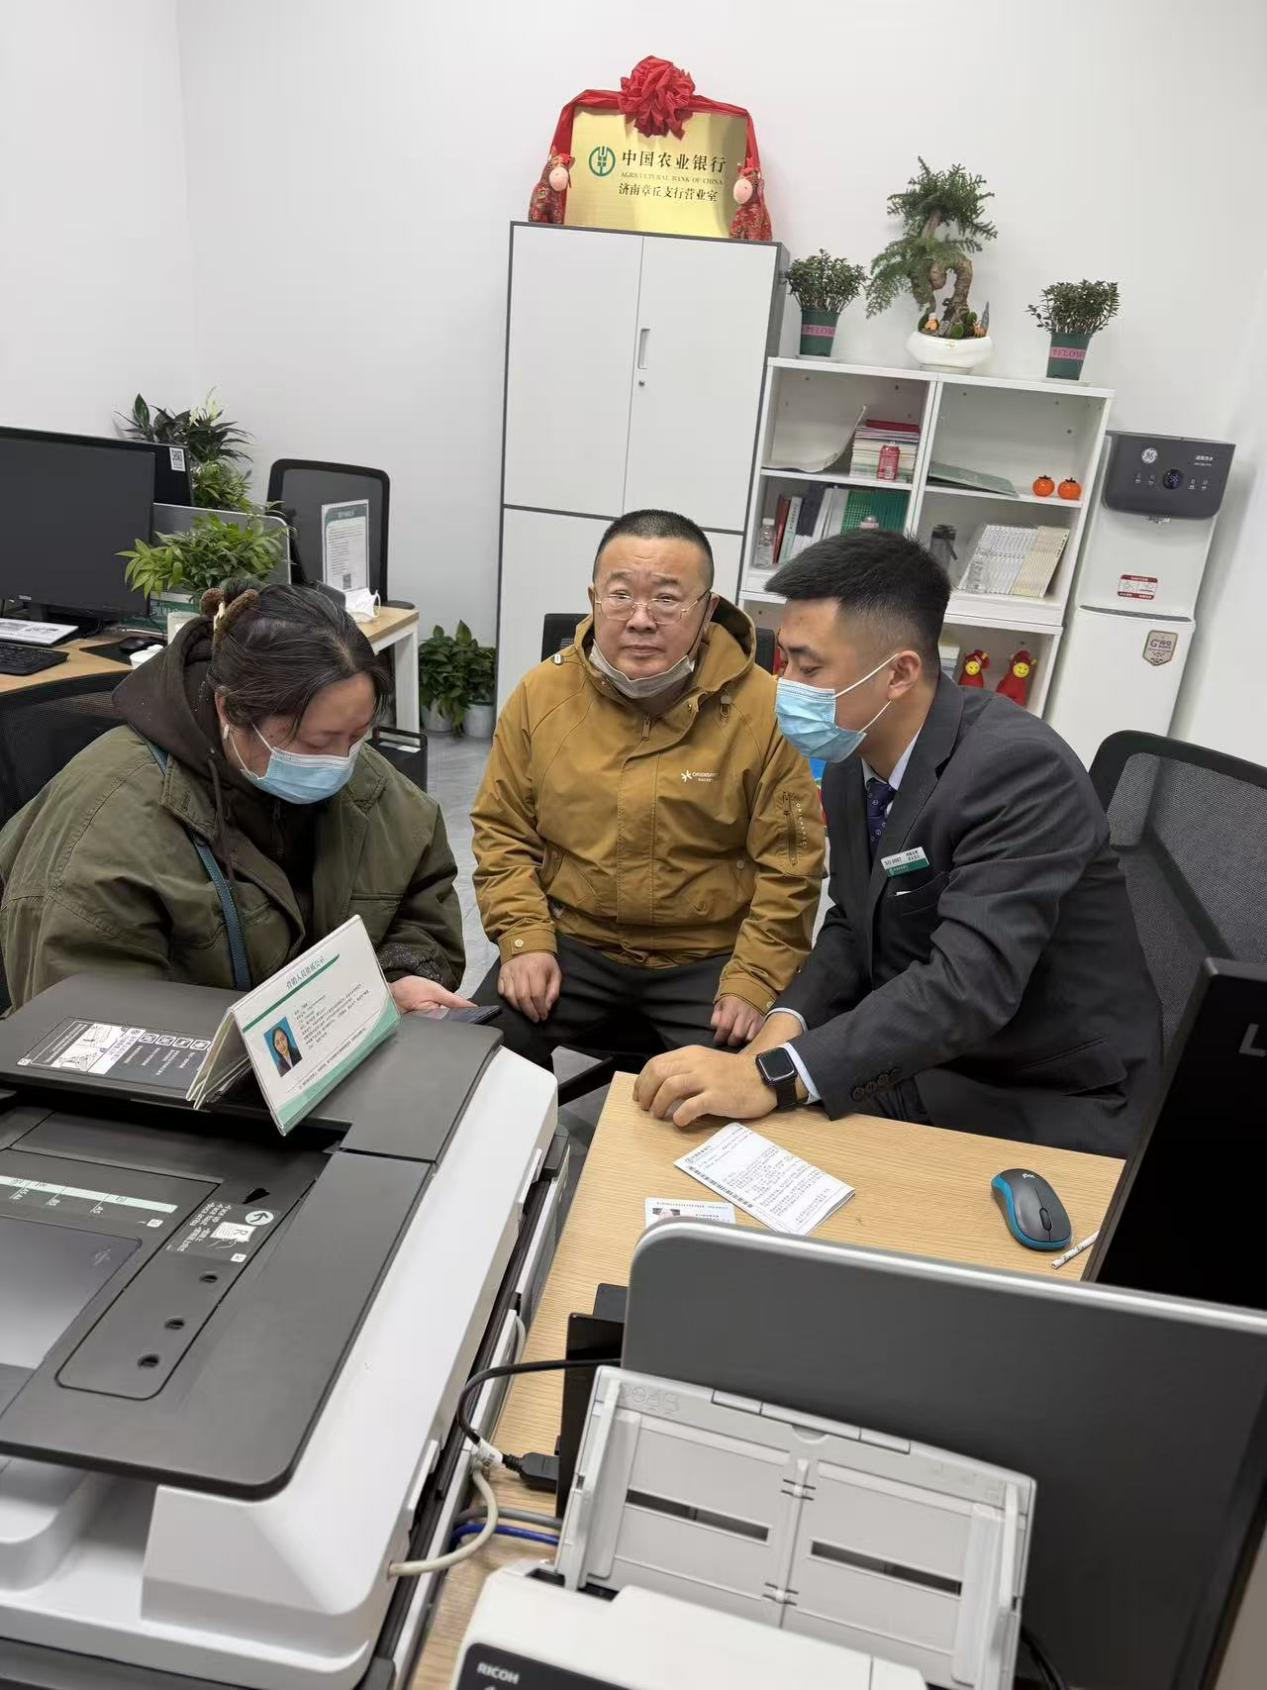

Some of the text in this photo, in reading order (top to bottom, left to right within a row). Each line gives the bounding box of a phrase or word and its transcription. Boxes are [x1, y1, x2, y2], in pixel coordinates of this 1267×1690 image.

[622, 149, 726, 173] 中国农业银行
[618, 183, 718, 201] 济南章丘支行营业室
[477, 1662, 519, 1685] RICOH
